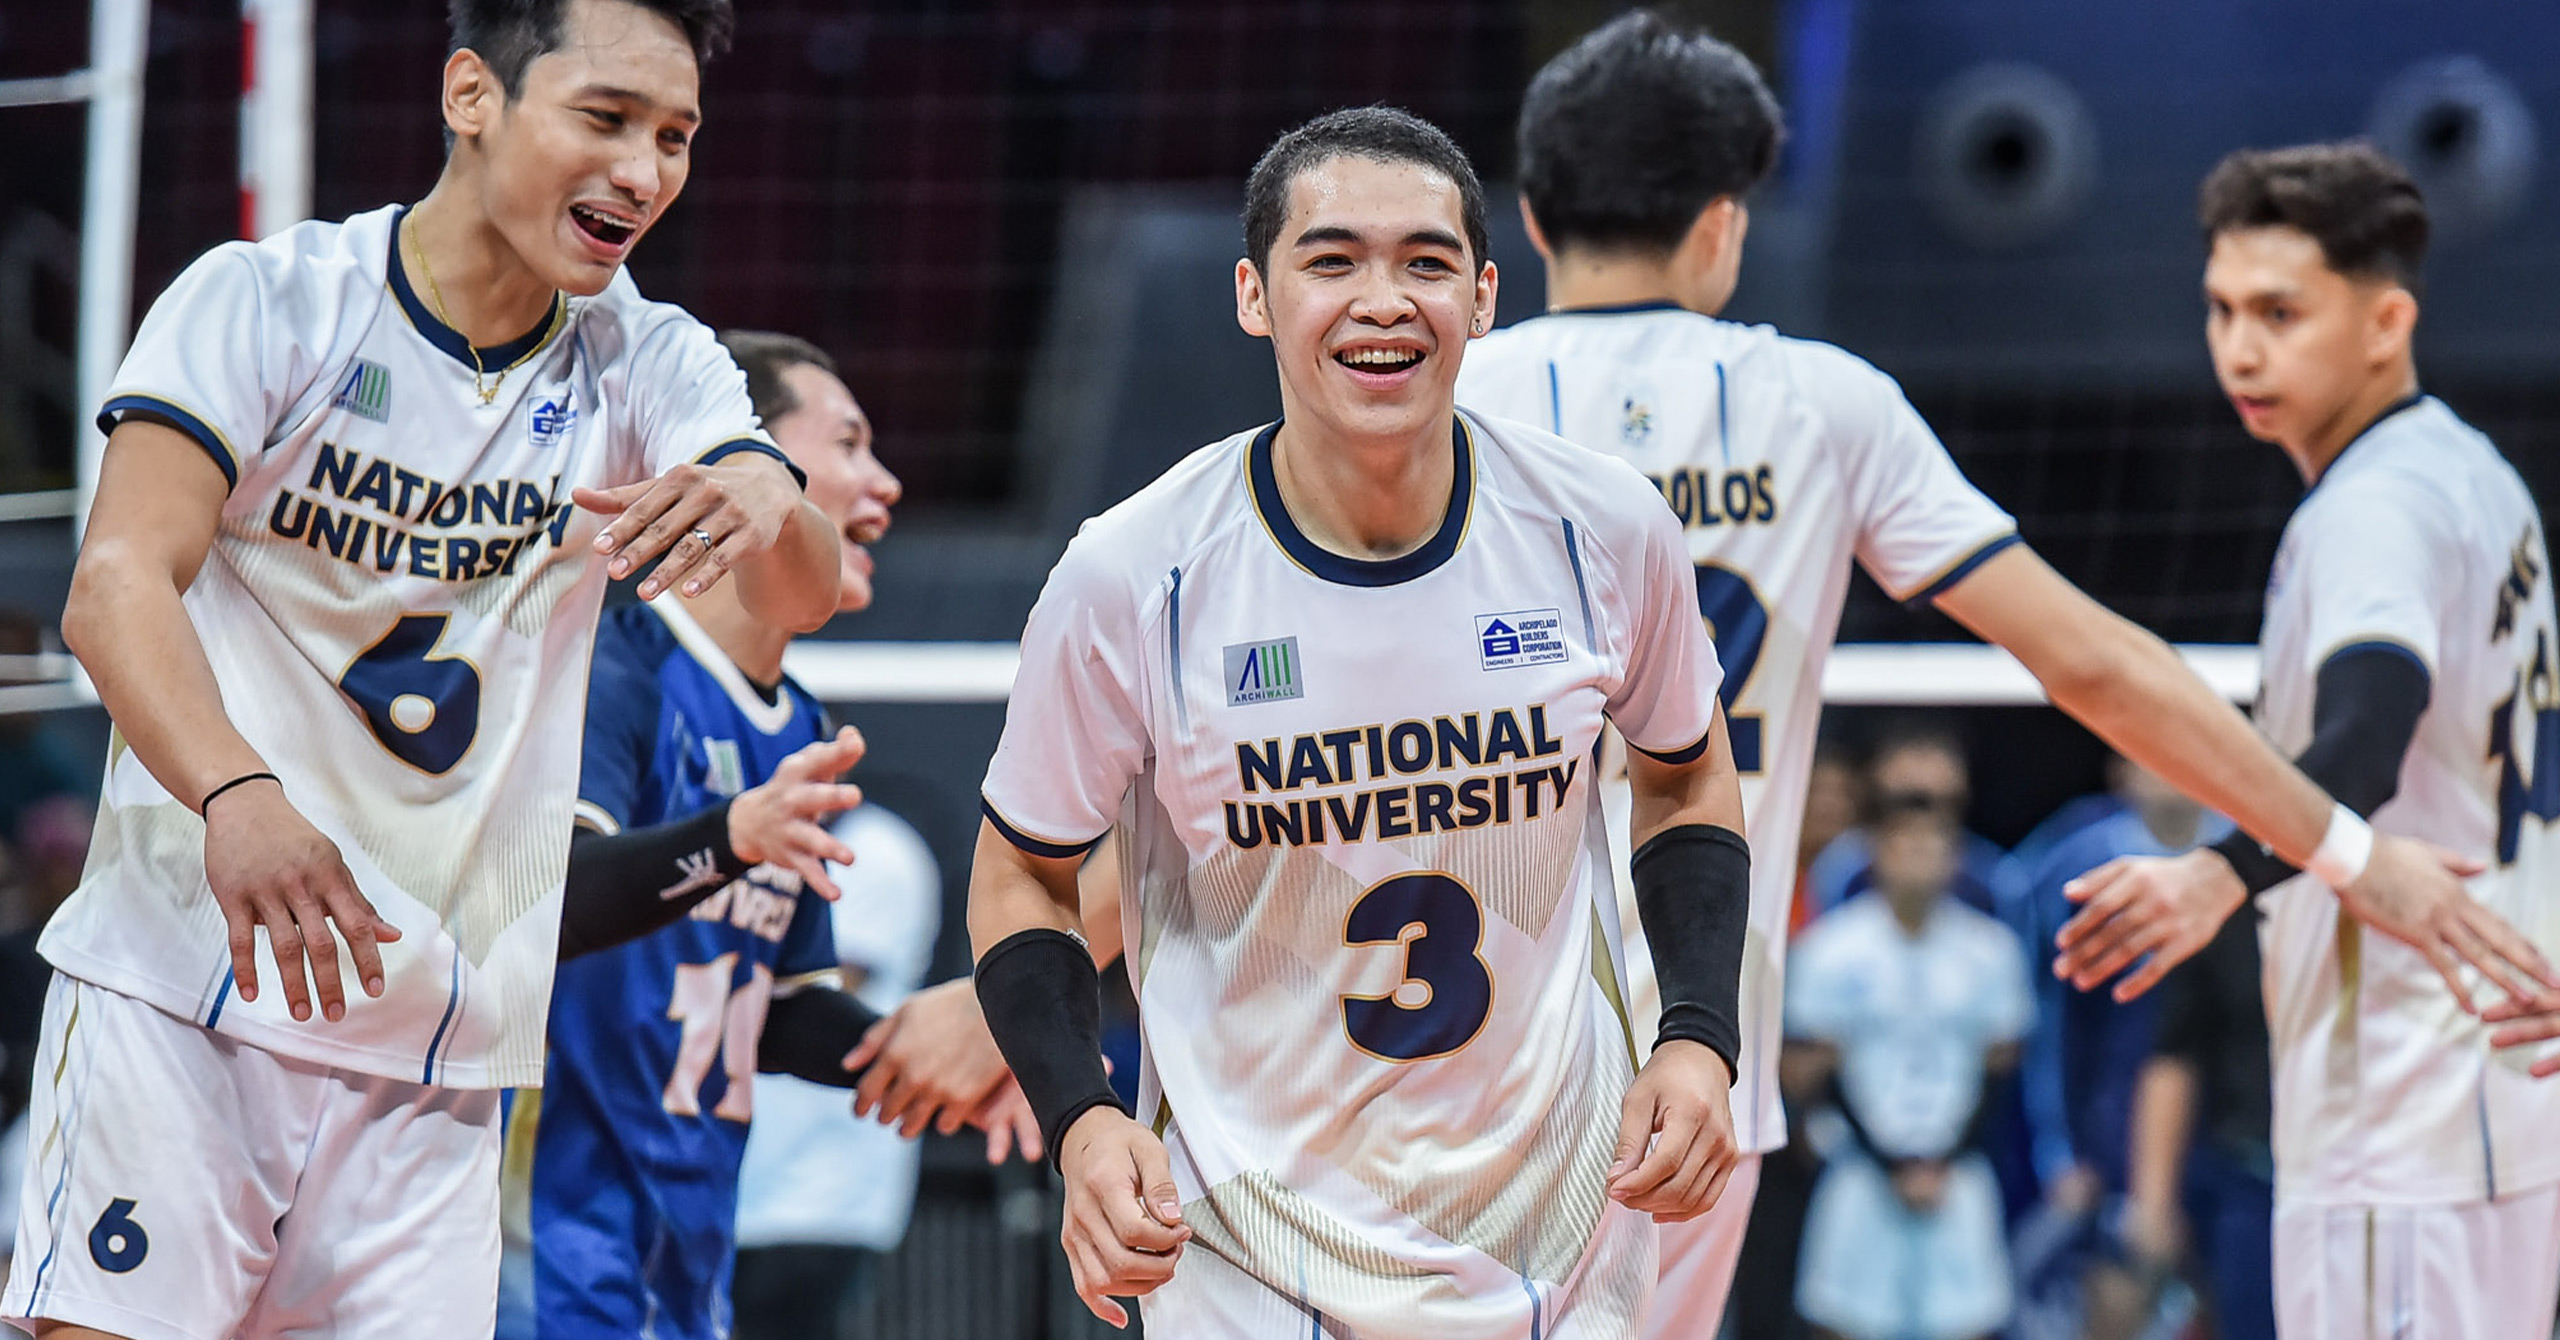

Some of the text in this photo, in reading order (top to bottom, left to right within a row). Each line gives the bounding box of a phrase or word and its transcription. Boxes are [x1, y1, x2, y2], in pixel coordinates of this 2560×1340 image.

[308, 440, 562, 530] NATIONAL
[1485, 652, 1564, 667] ENGINEERS CONTRACTORS
[1518, 619, 1558, 631] ARCHIPELAGO
[1520, 631, 1550, 642] BUILDERS
[1522, 641, 1563, 653] CORPORATION
[336, 610, 482, 778] 6
[1234, 688, 1295, 703] ARCHIWALL
[1234, 703, 1563, 794] NATIONAL
[1222, 755, 1581, 850] UNIVERSITY
[1339, 870, 1496, 1064] 3
[88, 1195, 150, 1274] 6
